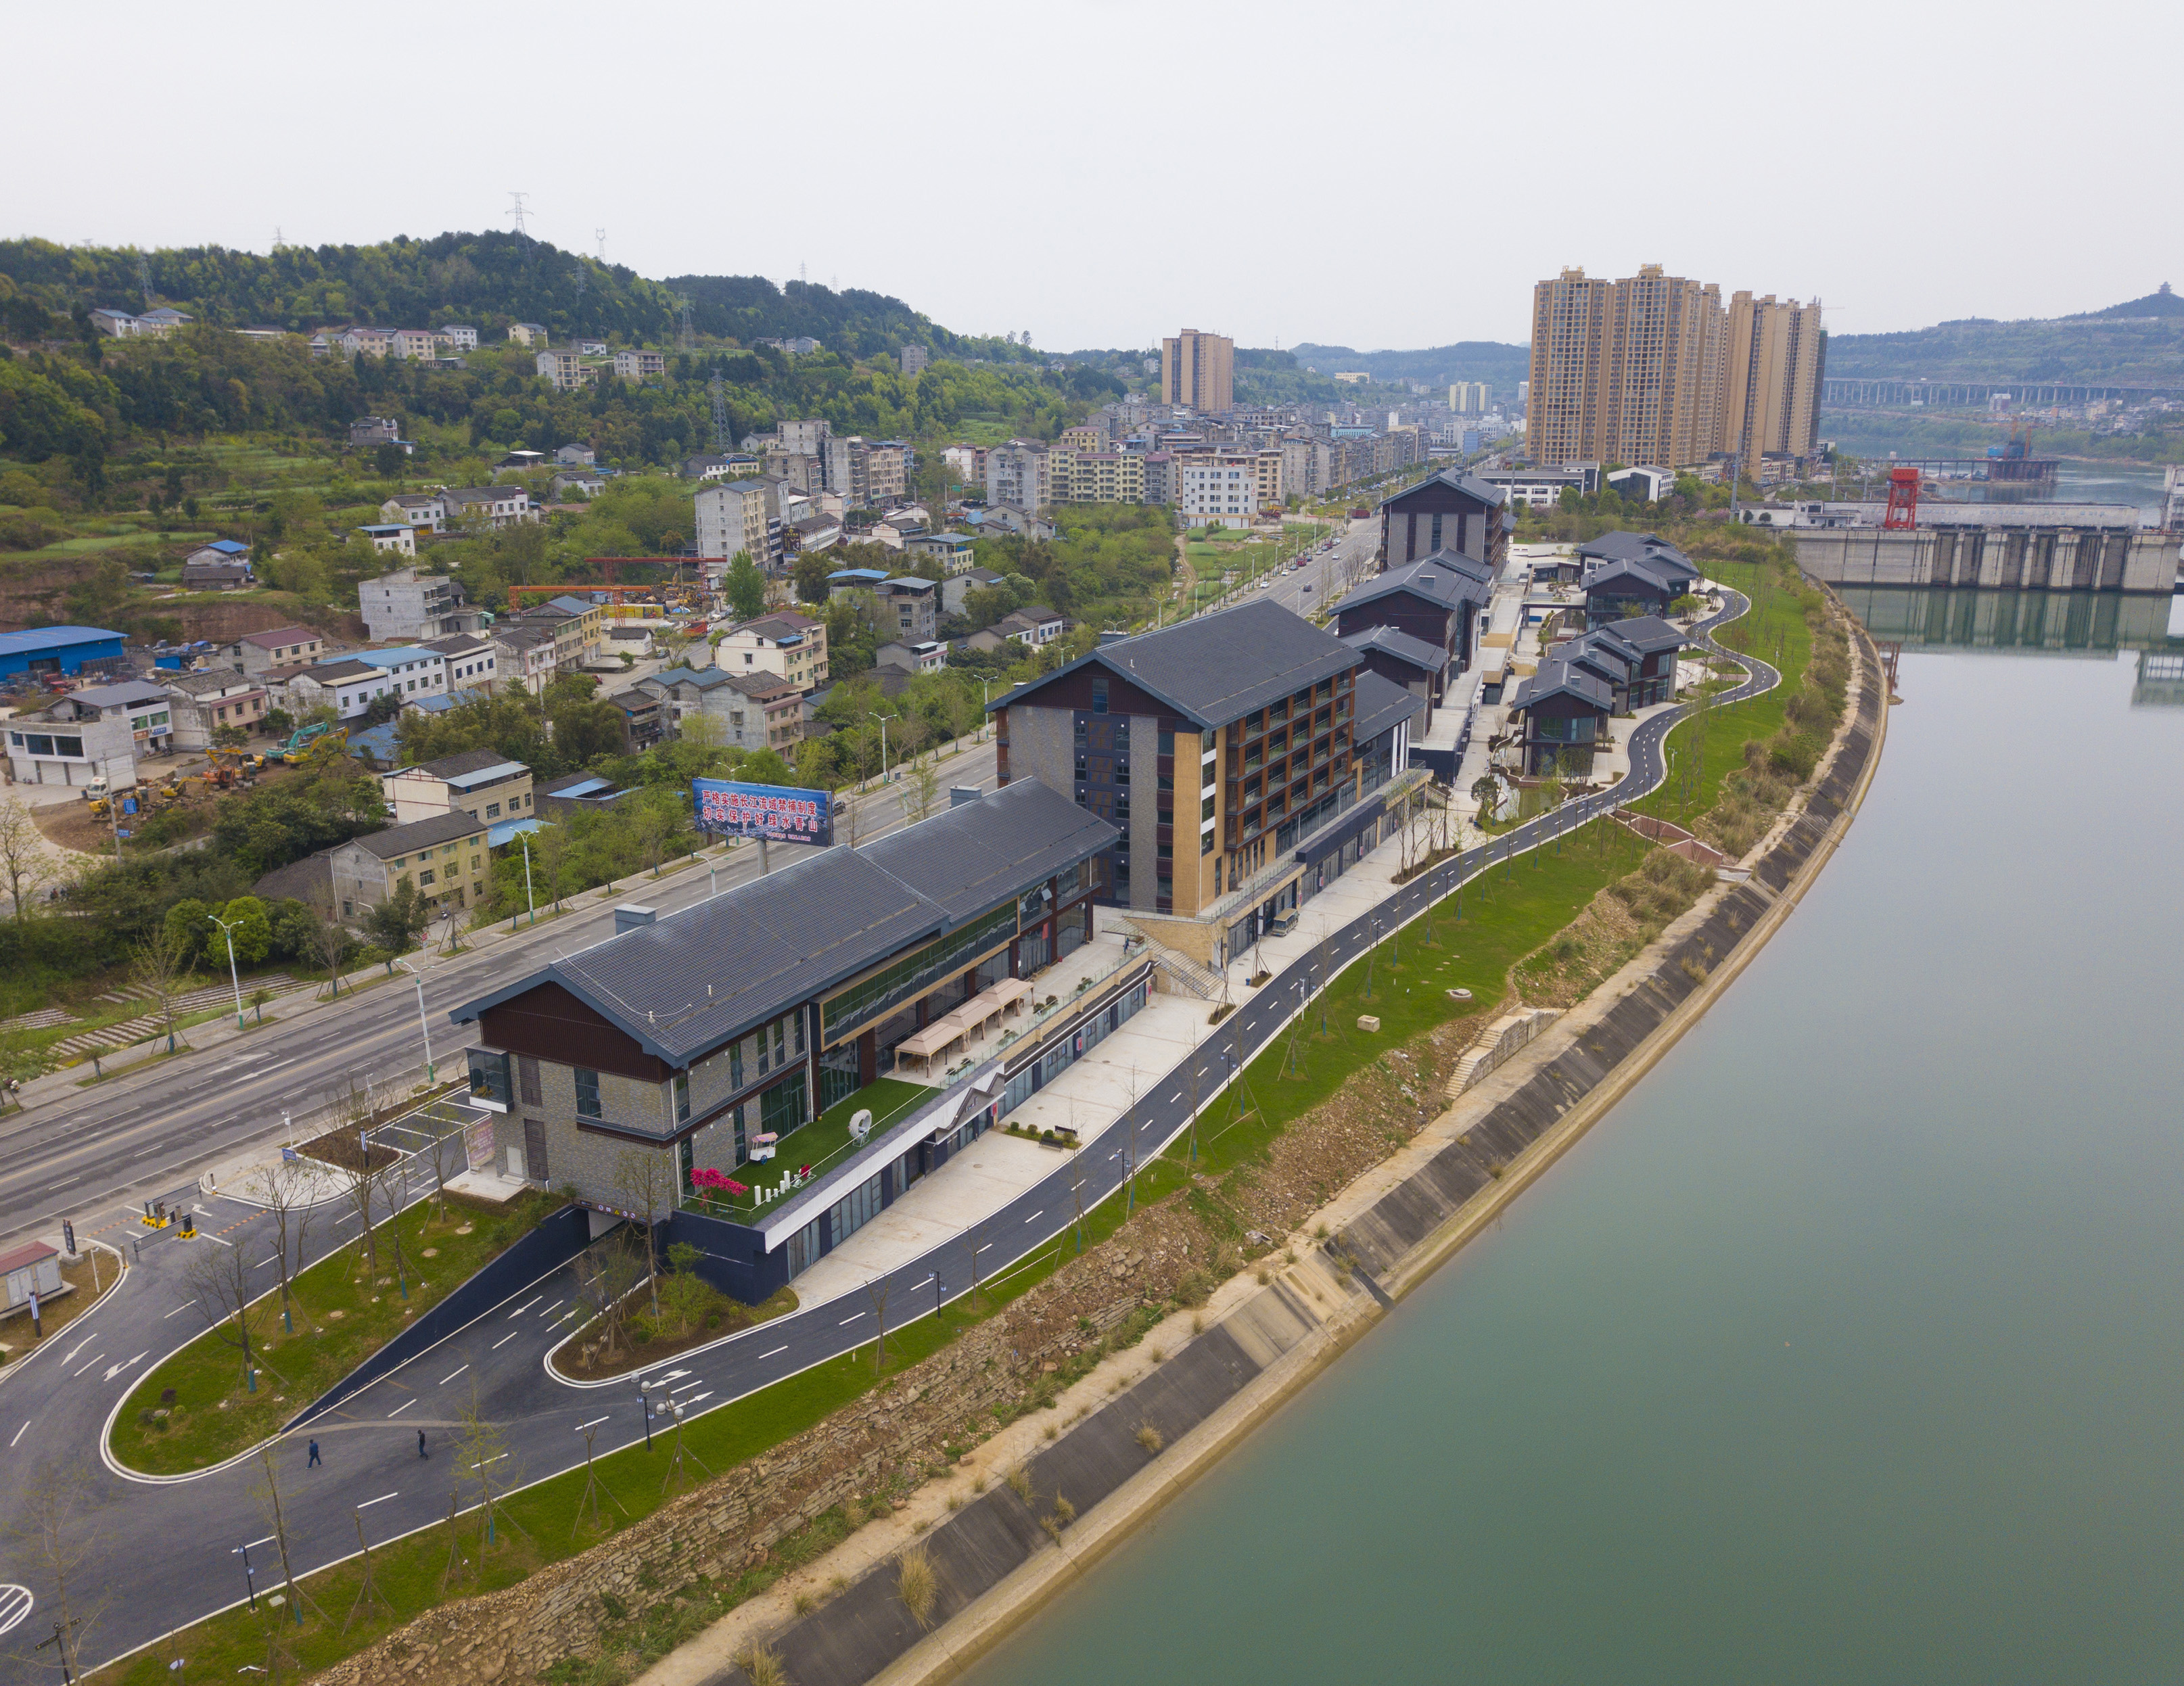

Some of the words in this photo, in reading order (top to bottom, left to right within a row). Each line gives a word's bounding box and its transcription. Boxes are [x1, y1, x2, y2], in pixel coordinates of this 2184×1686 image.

[702, 790, 816, 816] 严格实施长江流域禁捕制度
[703, 805, 818, 833] 切实保护好绿水青山
